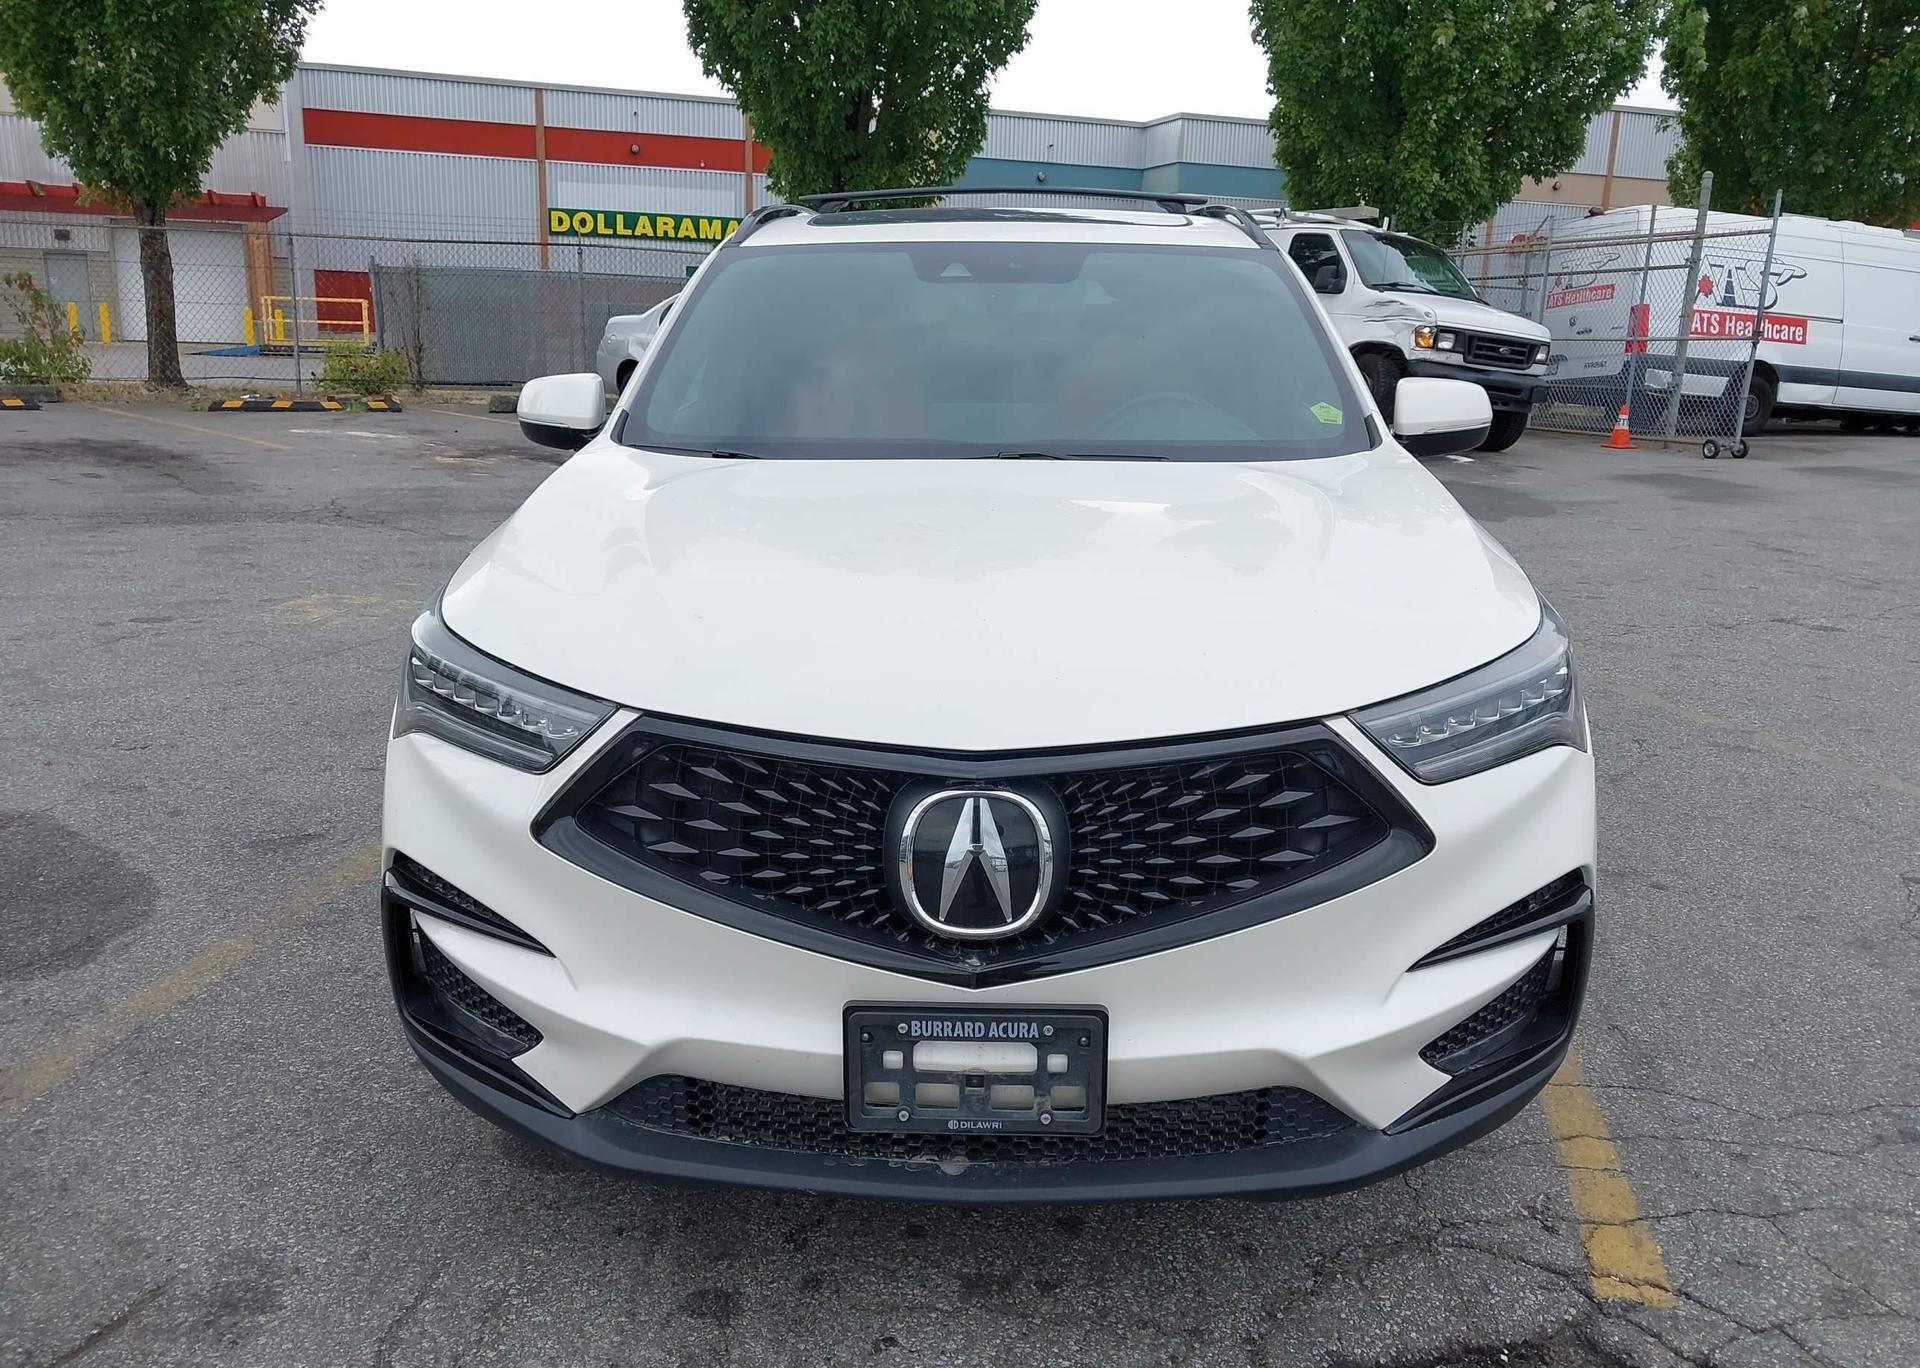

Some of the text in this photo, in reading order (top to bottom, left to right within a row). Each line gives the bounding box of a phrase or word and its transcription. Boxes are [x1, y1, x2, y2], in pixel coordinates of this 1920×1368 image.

[550, 210, 742, 240] DOLLARAMA
[1548, 288, 1612, 307] ATS Healthcare
[1691, 312, 1719, 334] ATS
[911, 1020, 1039, 1038] BURRARD ACURA
[960, 1121, 1002, 1129] DILAWRI
